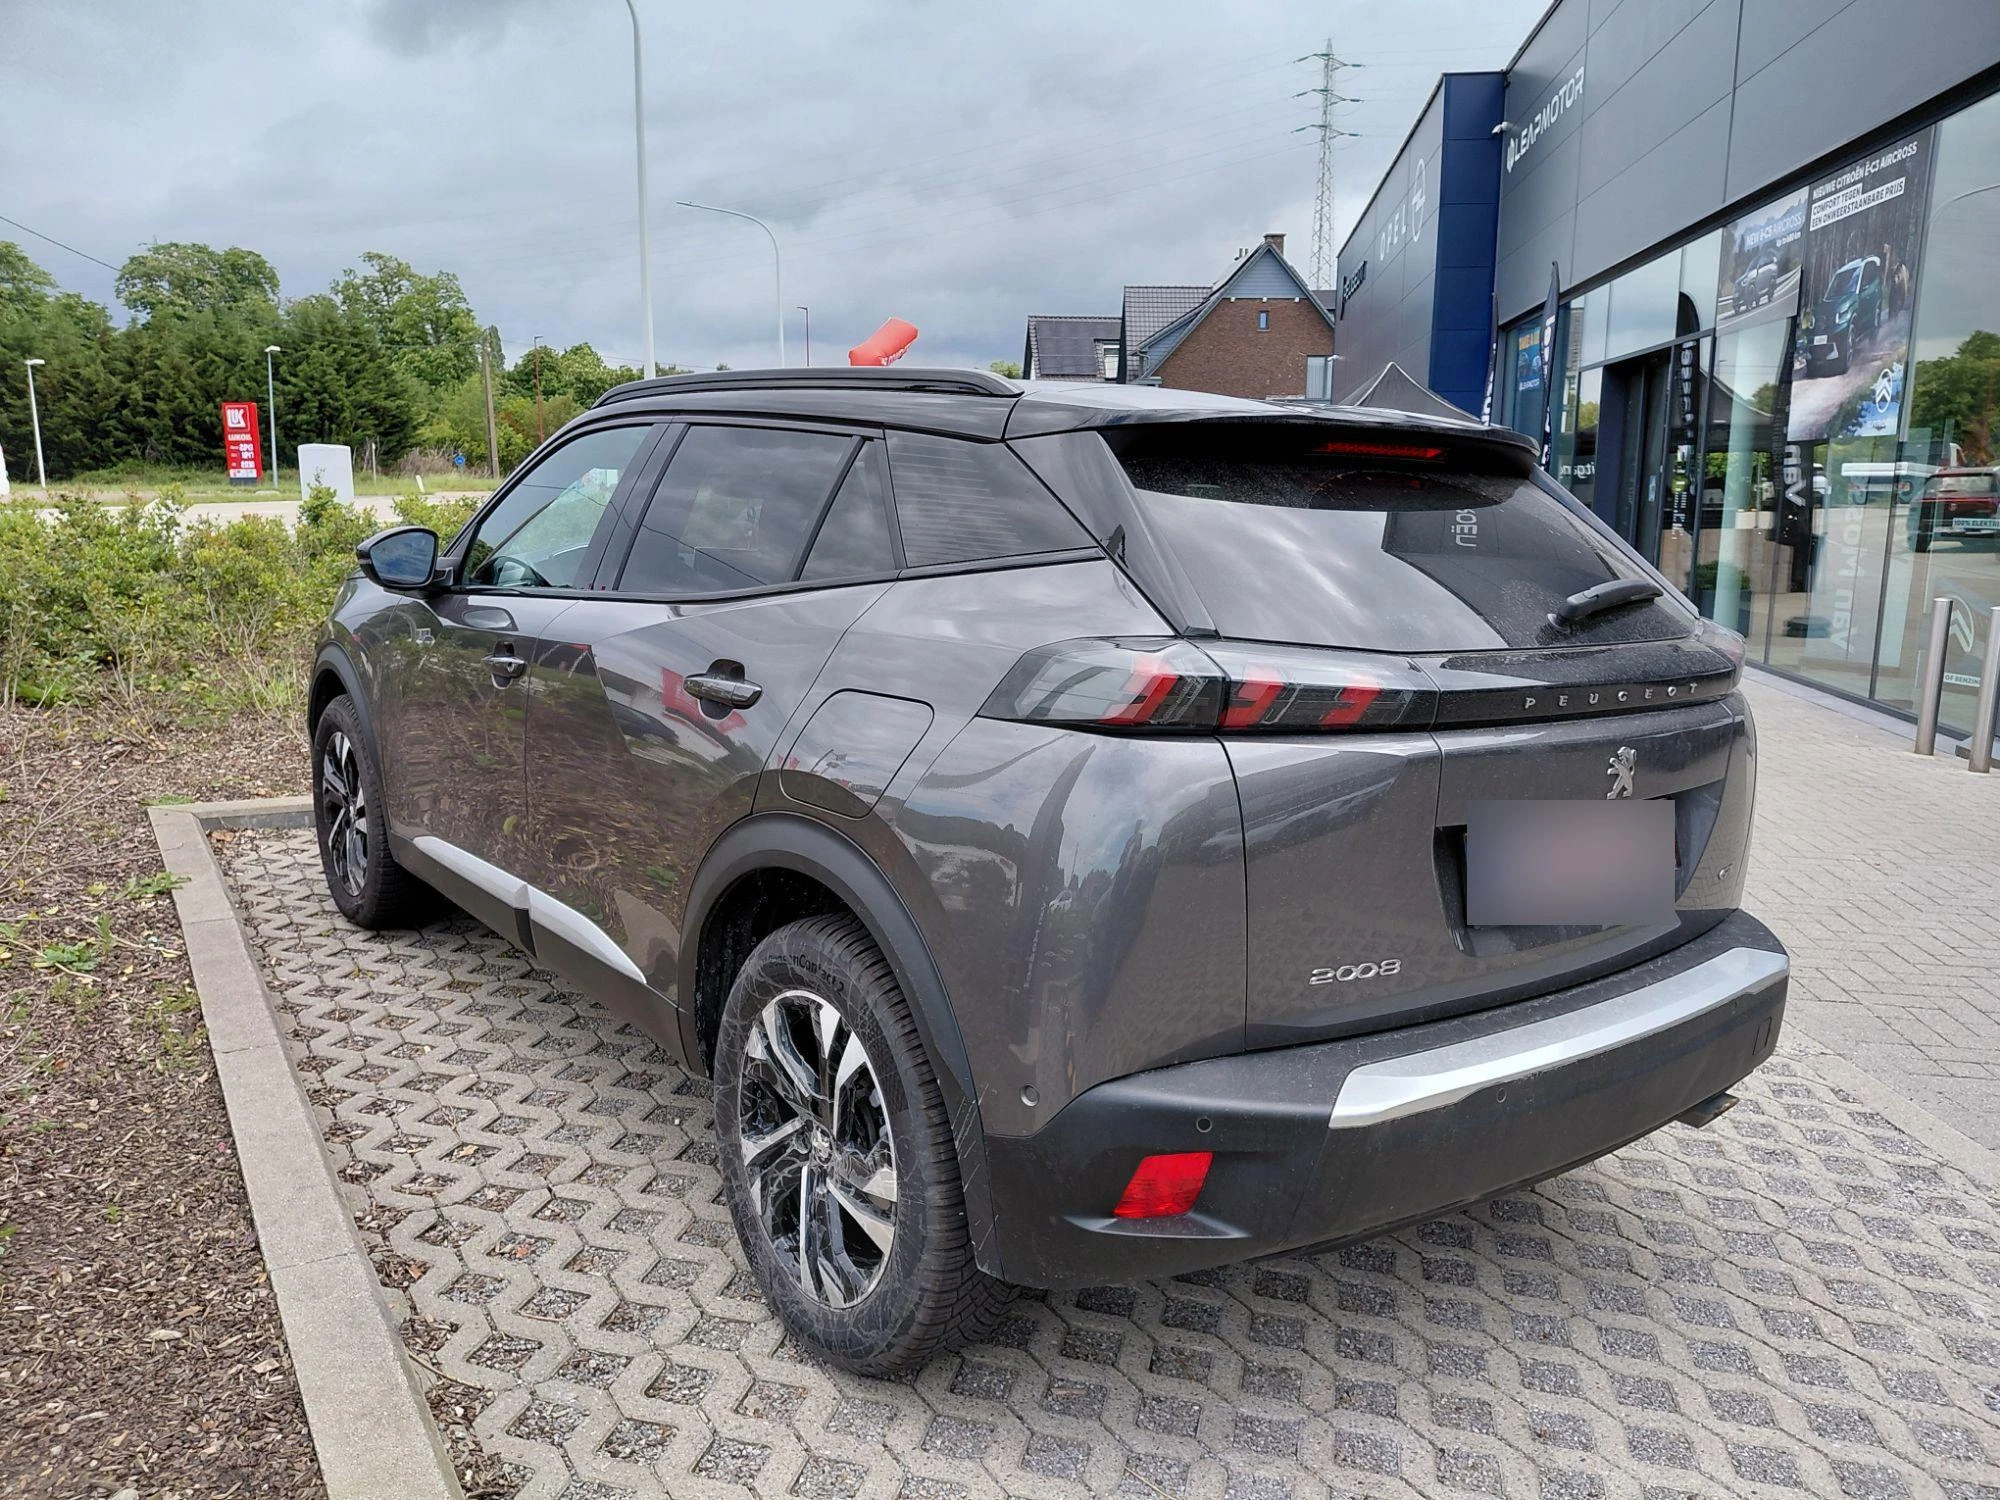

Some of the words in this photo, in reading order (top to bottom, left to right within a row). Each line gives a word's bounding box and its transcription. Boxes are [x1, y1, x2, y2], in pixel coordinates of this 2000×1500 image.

[1514, 66, 1585, 162] LEAPMOTOR
[1813, 179, 1837, 200] NIEUWE
[1836, 164, 1864, 189] CITROËN
[1880, 141, 1918, 169] AIRCROSS
[1811, 217, 1823, 229] EEN
[1822, 190, 1885, 224] ONWEERSTAANBARE
[1884, 181, 1904, 199] PRIJS
[1812, 195, 1841, 216] COMFORT
[1841, 185, 1862, 203] TEGEN
[1379, 203, 1408, 261] OPEL
[1524, 682, 1698, 709] PEUGEOT
[1309, 958, 1402, 985] 2008
